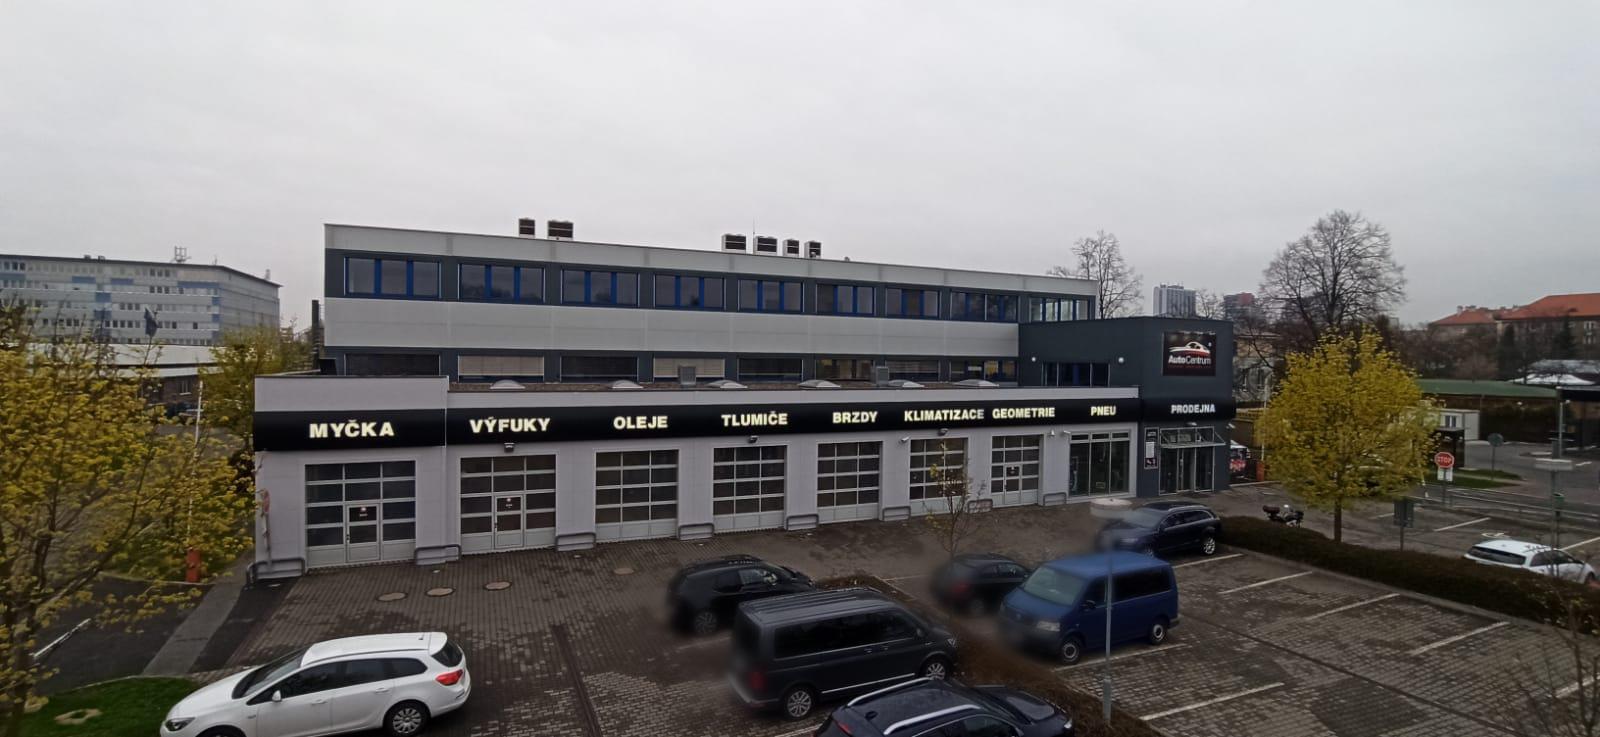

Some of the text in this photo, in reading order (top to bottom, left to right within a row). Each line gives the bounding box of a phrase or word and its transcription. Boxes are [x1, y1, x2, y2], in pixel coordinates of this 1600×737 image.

[1168, 355, 1211, 365] AutoCentrum
[992, 407, 1055, 419] GEOMETRIE
[1091, 406, 1116, 416] PNEU
[1171, 404, 1215, 413] PRODEJNA
[721, 411, 788, 426] TLUMIČE
[833, 411, 877, 423] BRZDY
[904, 409, 984, 421] KLIMATIZACE
[470, 416, 550, 433] VÝFUKY
[614, 416, 668, 429] OLEJE
[310, 420, 394, 438] MYČKA
